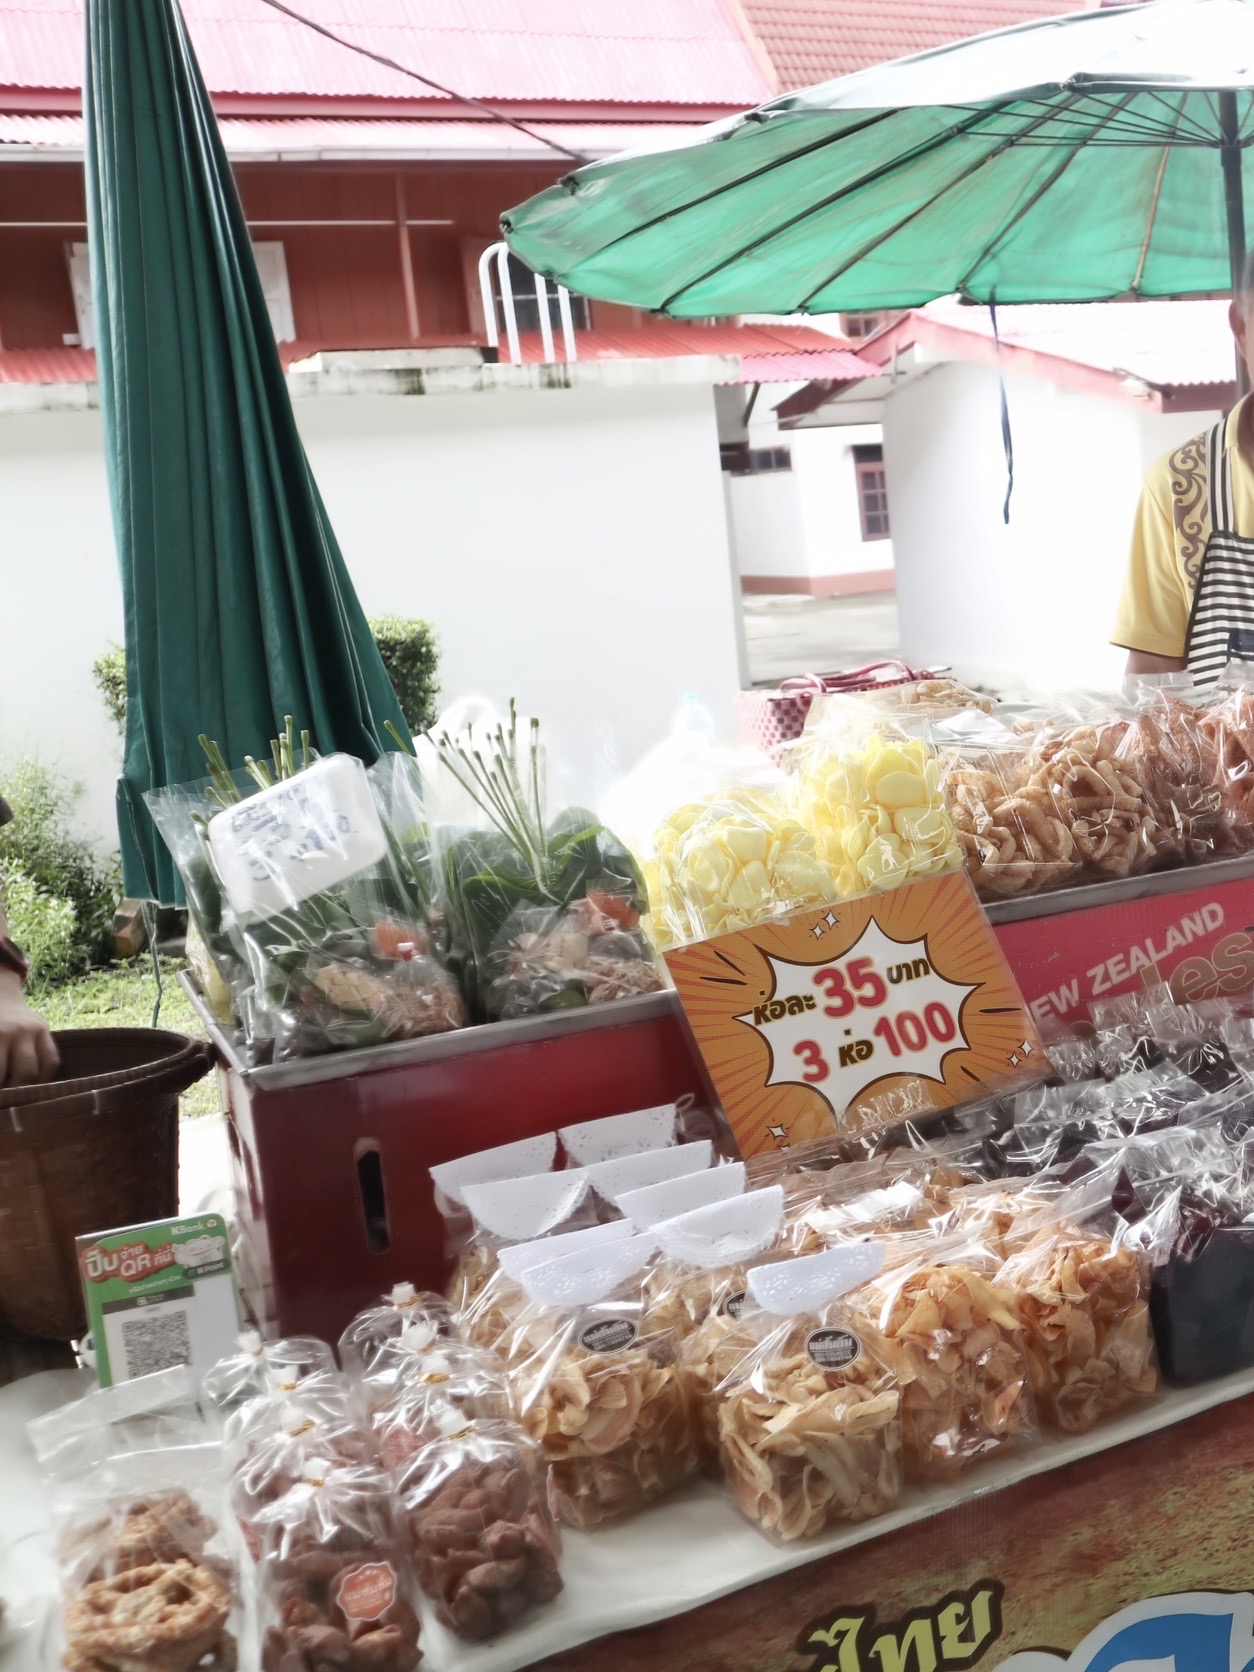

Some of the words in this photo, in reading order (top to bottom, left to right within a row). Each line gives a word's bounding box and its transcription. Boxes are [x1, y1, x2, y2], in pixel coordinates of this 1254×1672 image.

[1029, 978, 1081, 1024] EW
[1086, 902, 1226, 996] ZEALAND
[752, 990, 817, 1027] ห่อละ
[812, 955, 888, 1019] 35
[886, 957, 931, 985] บาท
[793, 1039, 830, 1083] 3
[838, 1028, 874, 1069] ห่อ
[873, 1002, 956, 1057] 100
[171, 1221, 206, 1236] KBank
[120, 1254, 151, 1277] QR
[205, 1262, 226, 1273] Point
